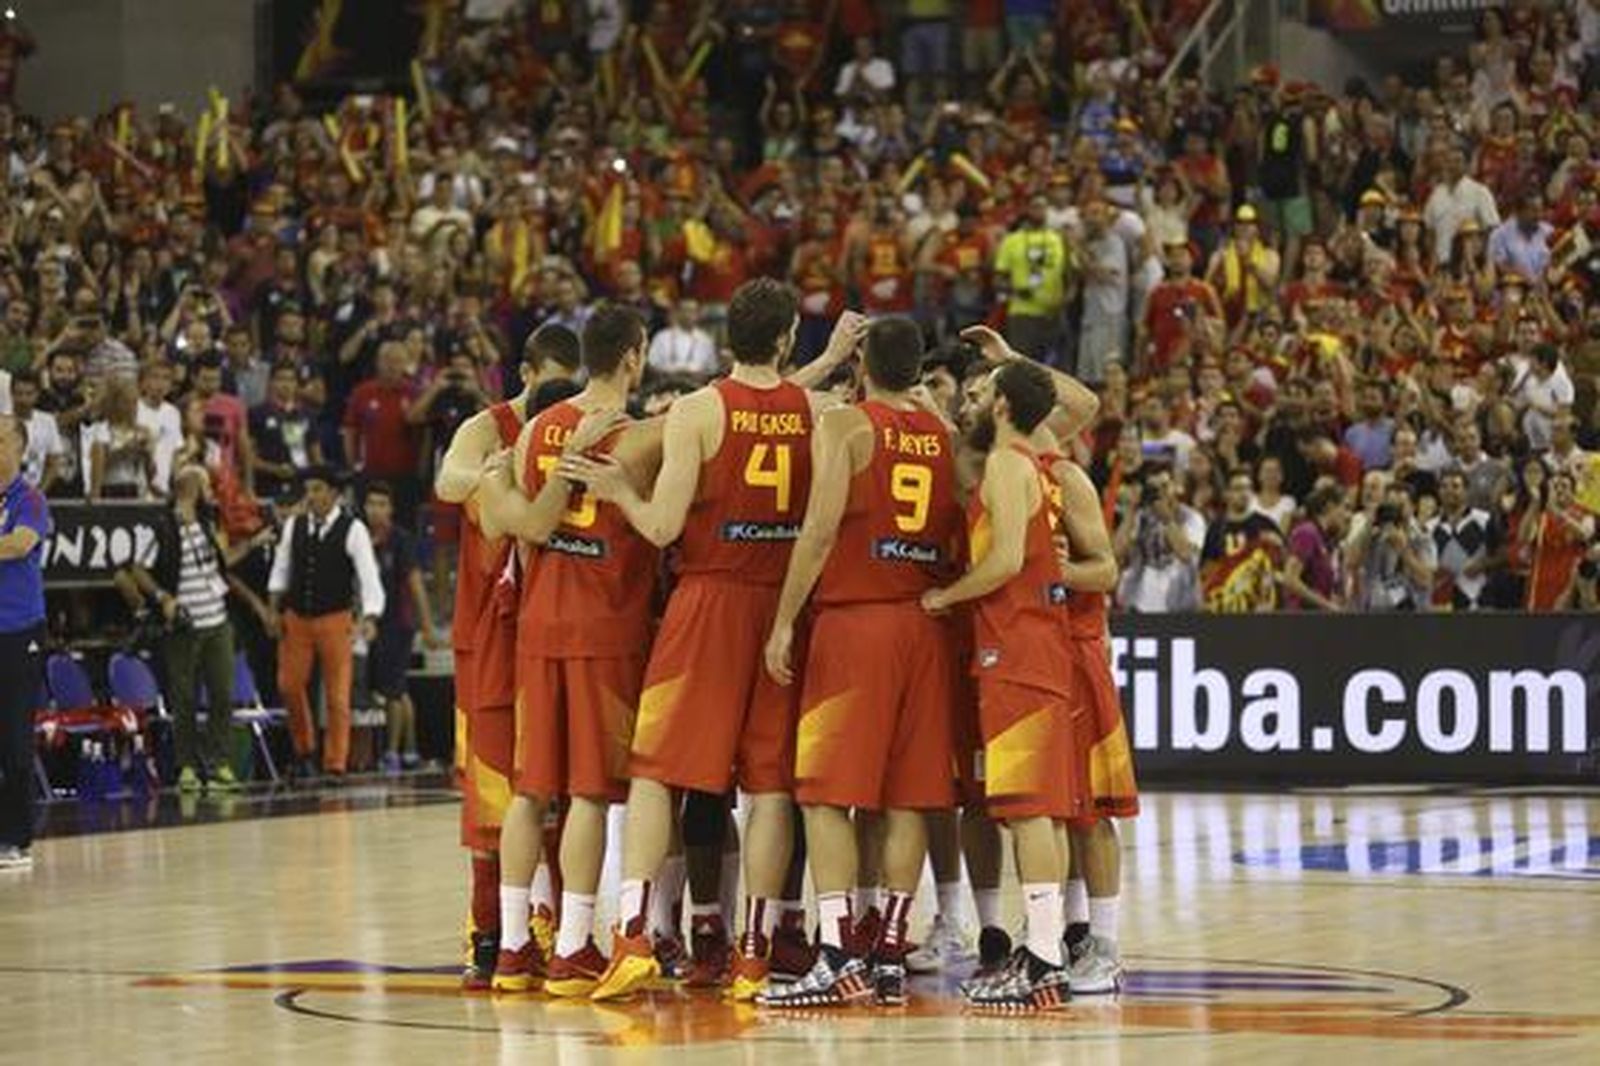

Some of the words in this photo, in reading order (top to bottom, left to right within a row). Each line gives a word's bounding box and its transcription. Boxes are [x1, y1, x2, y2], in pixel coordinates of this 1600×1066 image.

[731, 409, 758, 432] PAU
[760, 413, 806, 436] GASOL
[899, 431, 942, 457] REYES
[744, 443, 791, 512] 4
[891, 463, 933, 533] 9
